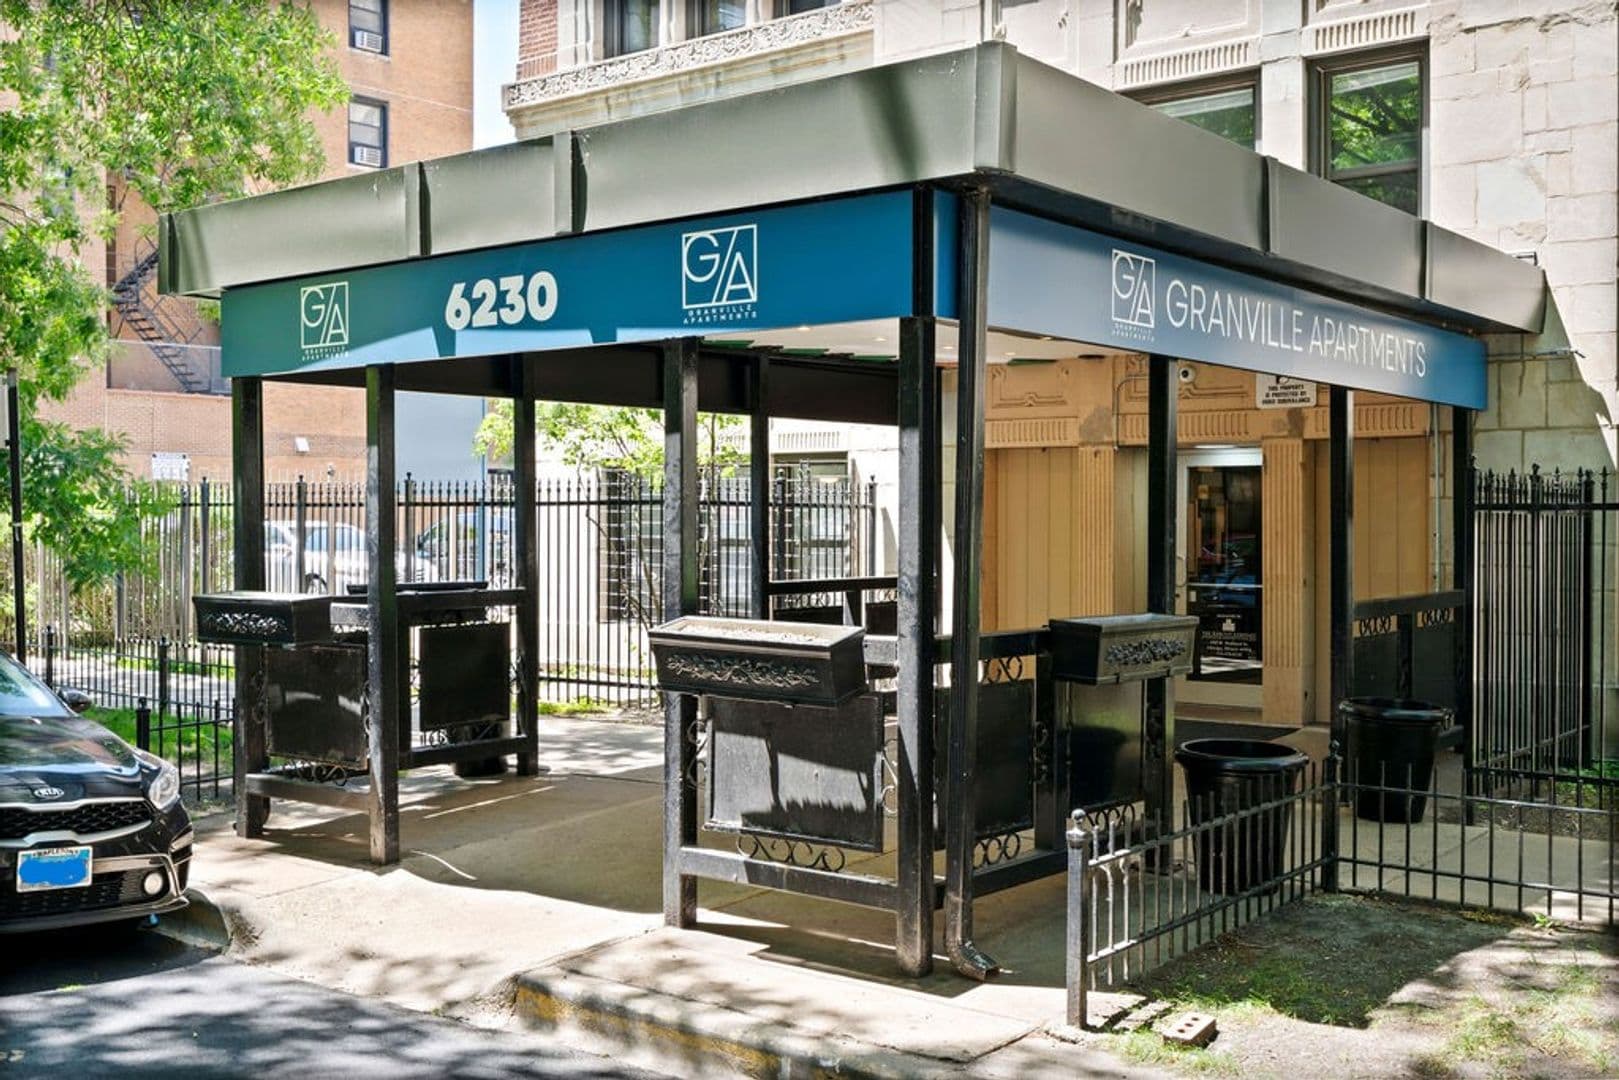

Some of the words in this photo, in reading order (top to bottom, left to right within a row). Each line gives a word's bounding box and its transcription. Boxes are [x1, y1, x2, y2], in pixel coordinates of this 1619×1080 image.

[445, 271, 558, 331] 6230
[1166, 280, 1304, 351] GRANVILLE
[1309, 316, 1426, 378] APARTMENTS
